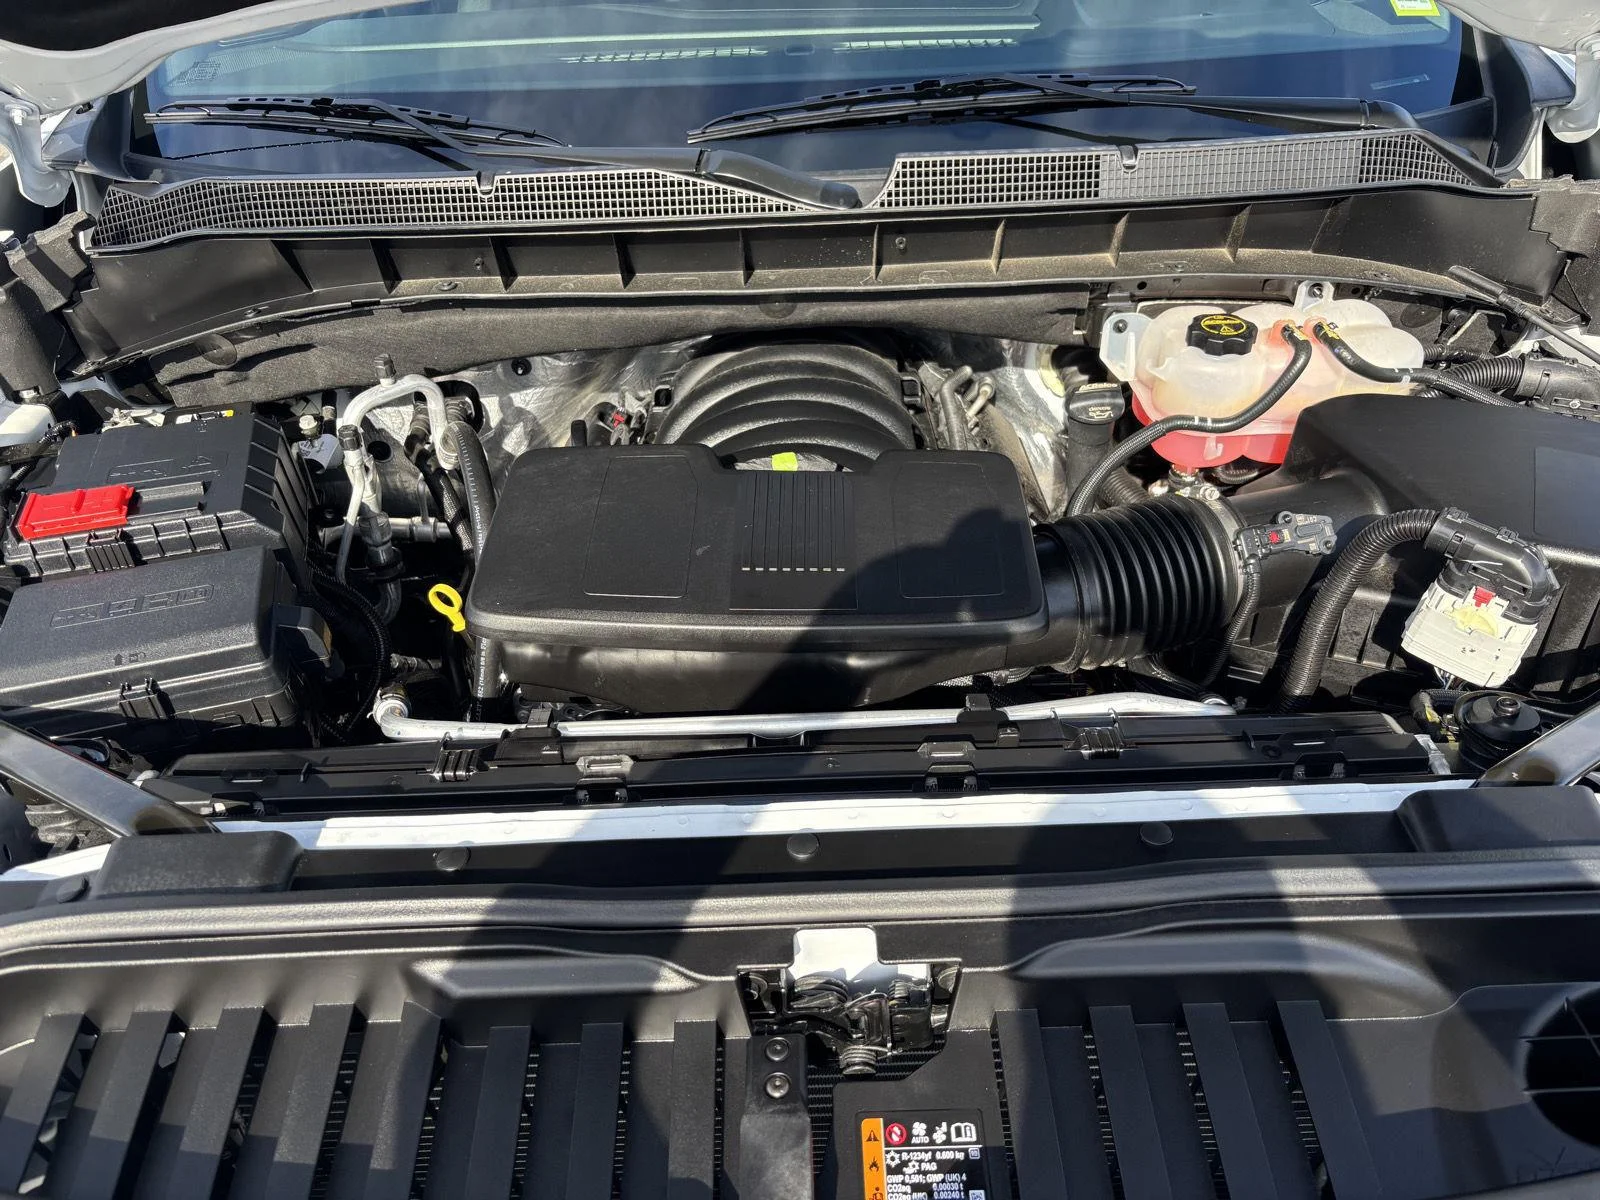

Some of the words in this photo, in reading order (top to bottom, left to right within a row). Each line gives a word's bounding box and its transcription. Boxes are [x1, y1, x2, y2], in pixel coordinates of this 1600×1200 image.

[911, 1136, 929, 1144] AUTO
[901, 1151, 932, 1161] R-1234yf
[955, 1151, 965, 1160] kg
[920, 1162, 938, 1171] PAG
[886, 1175, 903, 1183] GWP
[926, 1174, 944, 1183] GWP
[945, 1173, 961, 1182] (UK)
[961, 1173, 967, 1181] 4
[887, 1184, 912, 1193] CO2eq
[912, 1192, 928, 1200] (UK)
